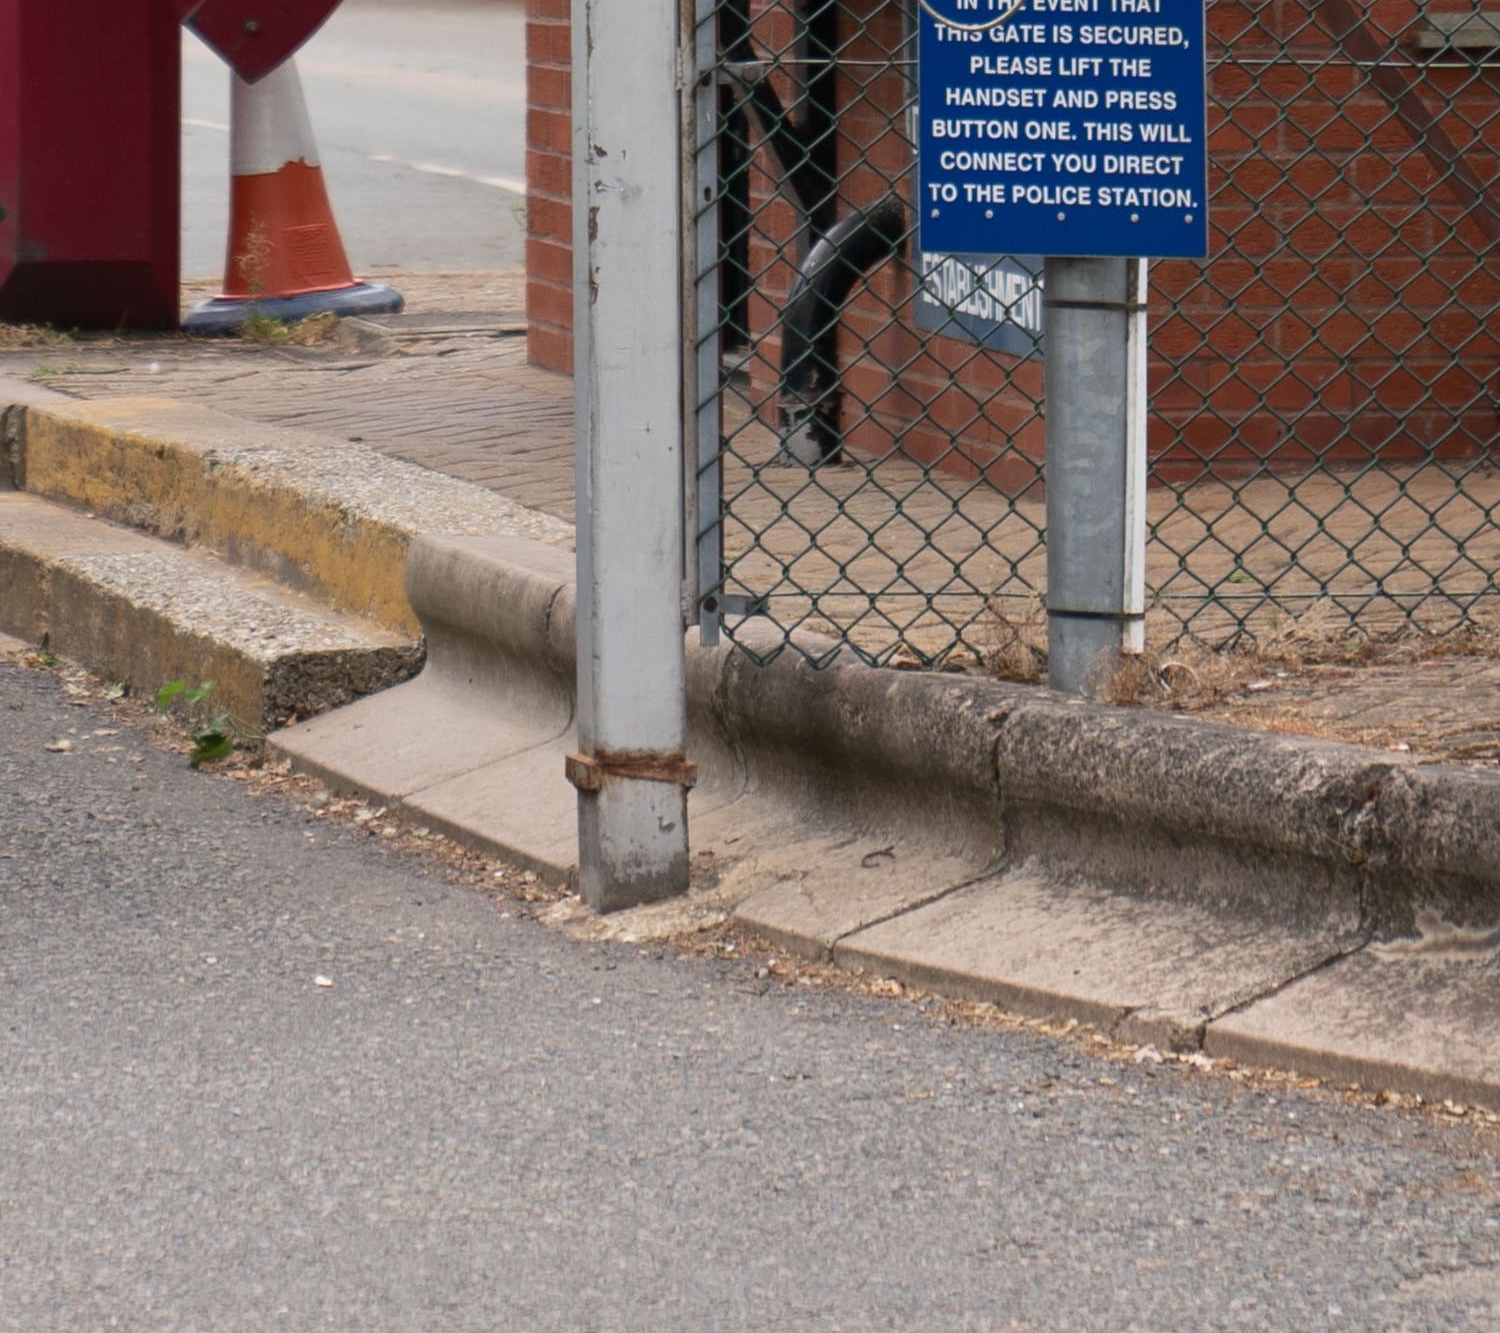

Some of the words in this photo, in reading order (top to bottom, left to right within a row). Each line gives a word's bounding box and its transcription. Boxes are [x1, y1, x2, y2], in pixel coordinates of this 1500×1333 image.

[989, 24, 1046, 43] GATE
[1053, 25, 1073, 44] IS
[1080, 26, 1189, 49] SECURED,
[970, 56, 1052, 75] PLEASE
[1058, 57, 1103, 77] LIFT
[1109, 58, 1152, 77] THE
[946, 88, 1047, 108] HANDSET
[1053, 90, 1098, 109] AND
[1105, 91, 1177, 110] PRESS
[932, 119, 1018, 139] BUTTON
[1025, 121, 1077, 140] ONE.
[1084, 122, 1133, 142] THIS
[1140, 123, 1192, 143] WILL
[940, 151, 1045, 172] CONNECT
[1051, 154, 1097, 173] YOU
[1103, 156, 1184, 175] DIRECT
[928, 183, 957, 202] TO
[964, 184, 1005, 203] THE
[1012, 185, 1091, 205] POLICE
[1098, 187, 1198, 208] STATION.
[922, 251, 1044, 332] ESTABLISHMENT
